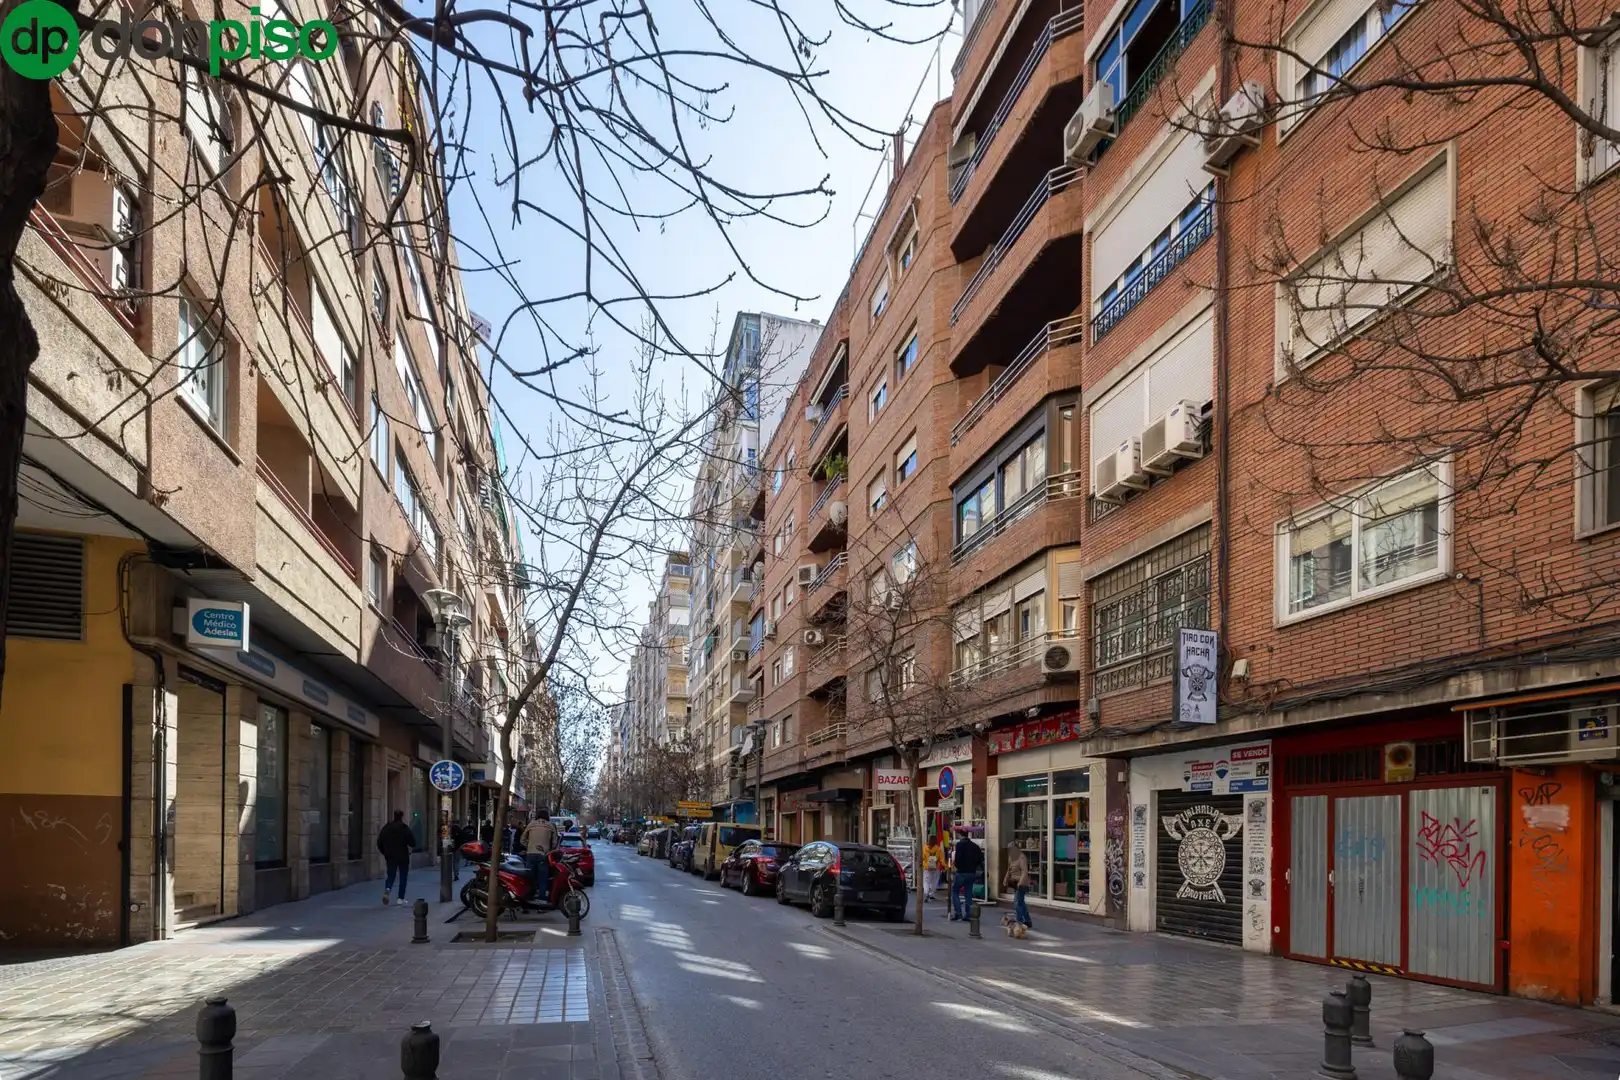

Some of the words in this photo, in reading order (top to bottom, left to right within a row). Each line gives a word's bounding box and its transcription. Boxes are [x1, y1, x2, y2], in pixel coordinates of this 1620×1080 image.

[204, 611, 235, 621] Centro
[204, 619, 237, 629] Médico
[204, 627, 238, 637] Adeslas
[1182, 632, 1198, 646] TIRO
[1199, 635, 1215, 649] CON
[1186, 646, 1210, 662] HACHA
[1243, 748, 1268, 758] VENDE
[878, 775, 911, 785] BAZAR
[1180, 804, 1220, 823] VALHALLA
[1191, 818, 1212, 829] AXE
[1180, 886, 1222, 903] BROTHER
